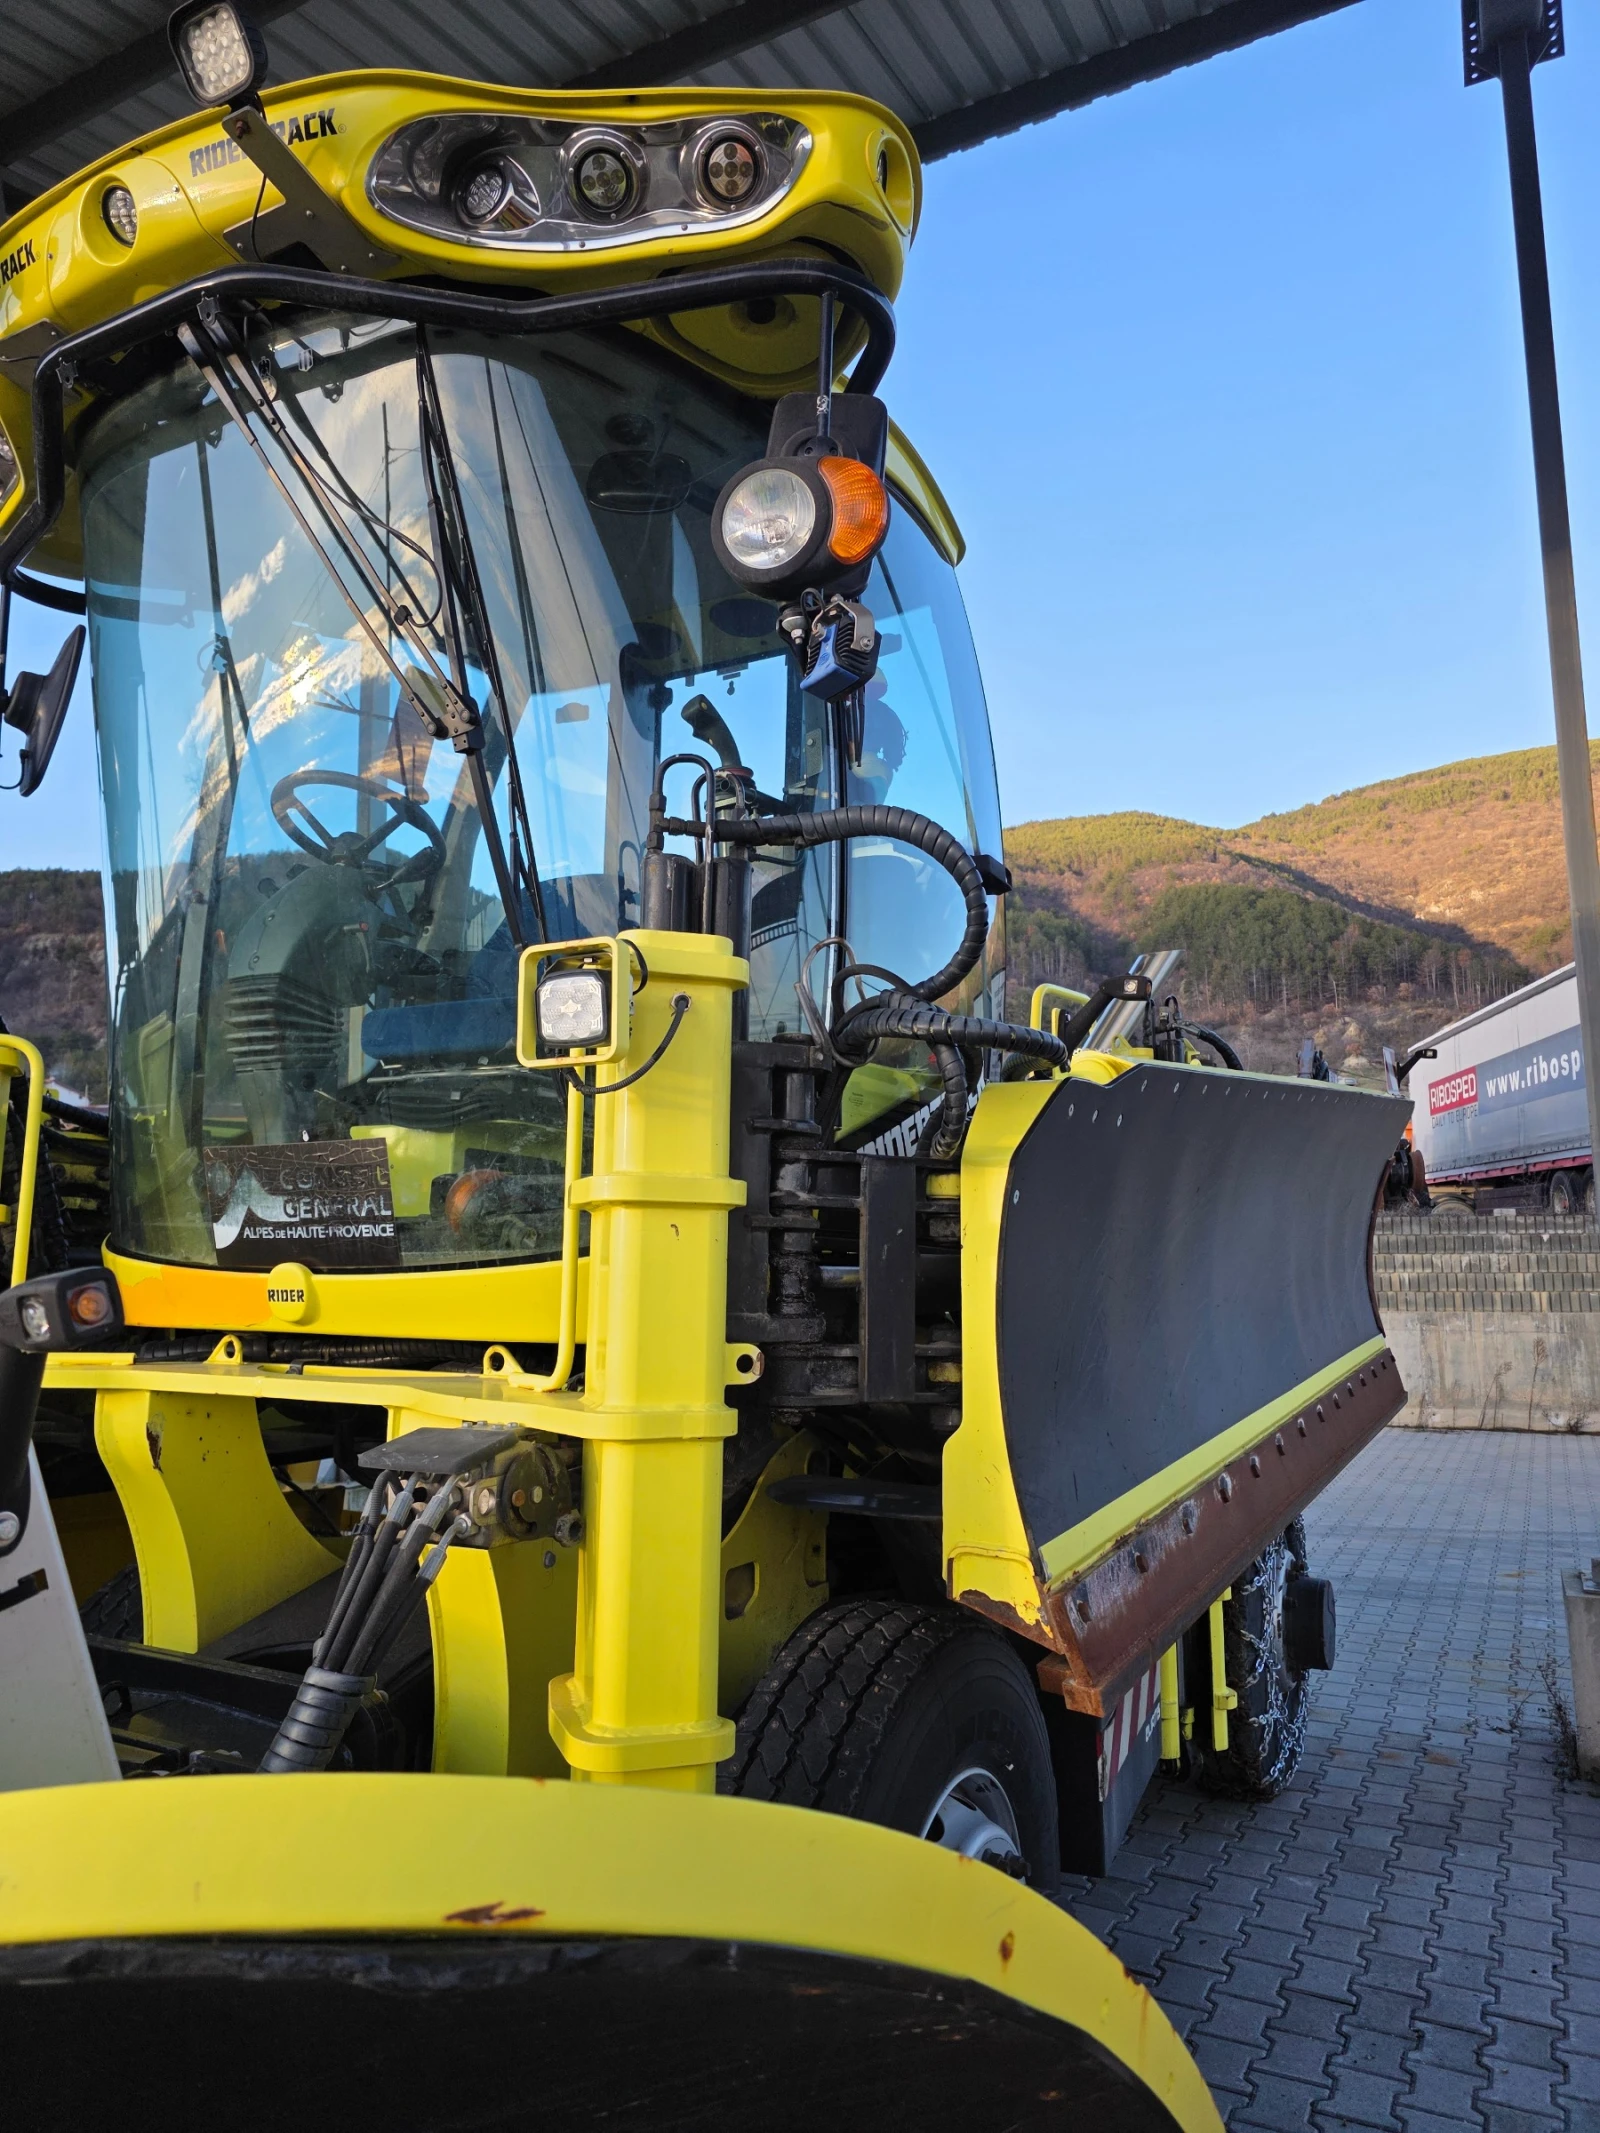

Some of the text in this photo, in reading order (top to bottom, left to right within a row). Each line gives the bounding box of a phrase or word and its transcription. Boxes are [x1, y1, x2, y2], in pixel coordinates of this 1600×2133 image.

[0, 238, 36, 287] RACK
[1486, 1049, 1584, 1098] www.ribosp
[1430, 1073, 1476, 1110] RIBOSPED
[1432, 1104, 1478, 1129] DAILY TO EUROPE
[243, 1226, 275, 1239] ALPES
[287, 1224, 395, 1239] HAUTE-PROVENCE
[267, 1288, 305, 1303] RIDER
